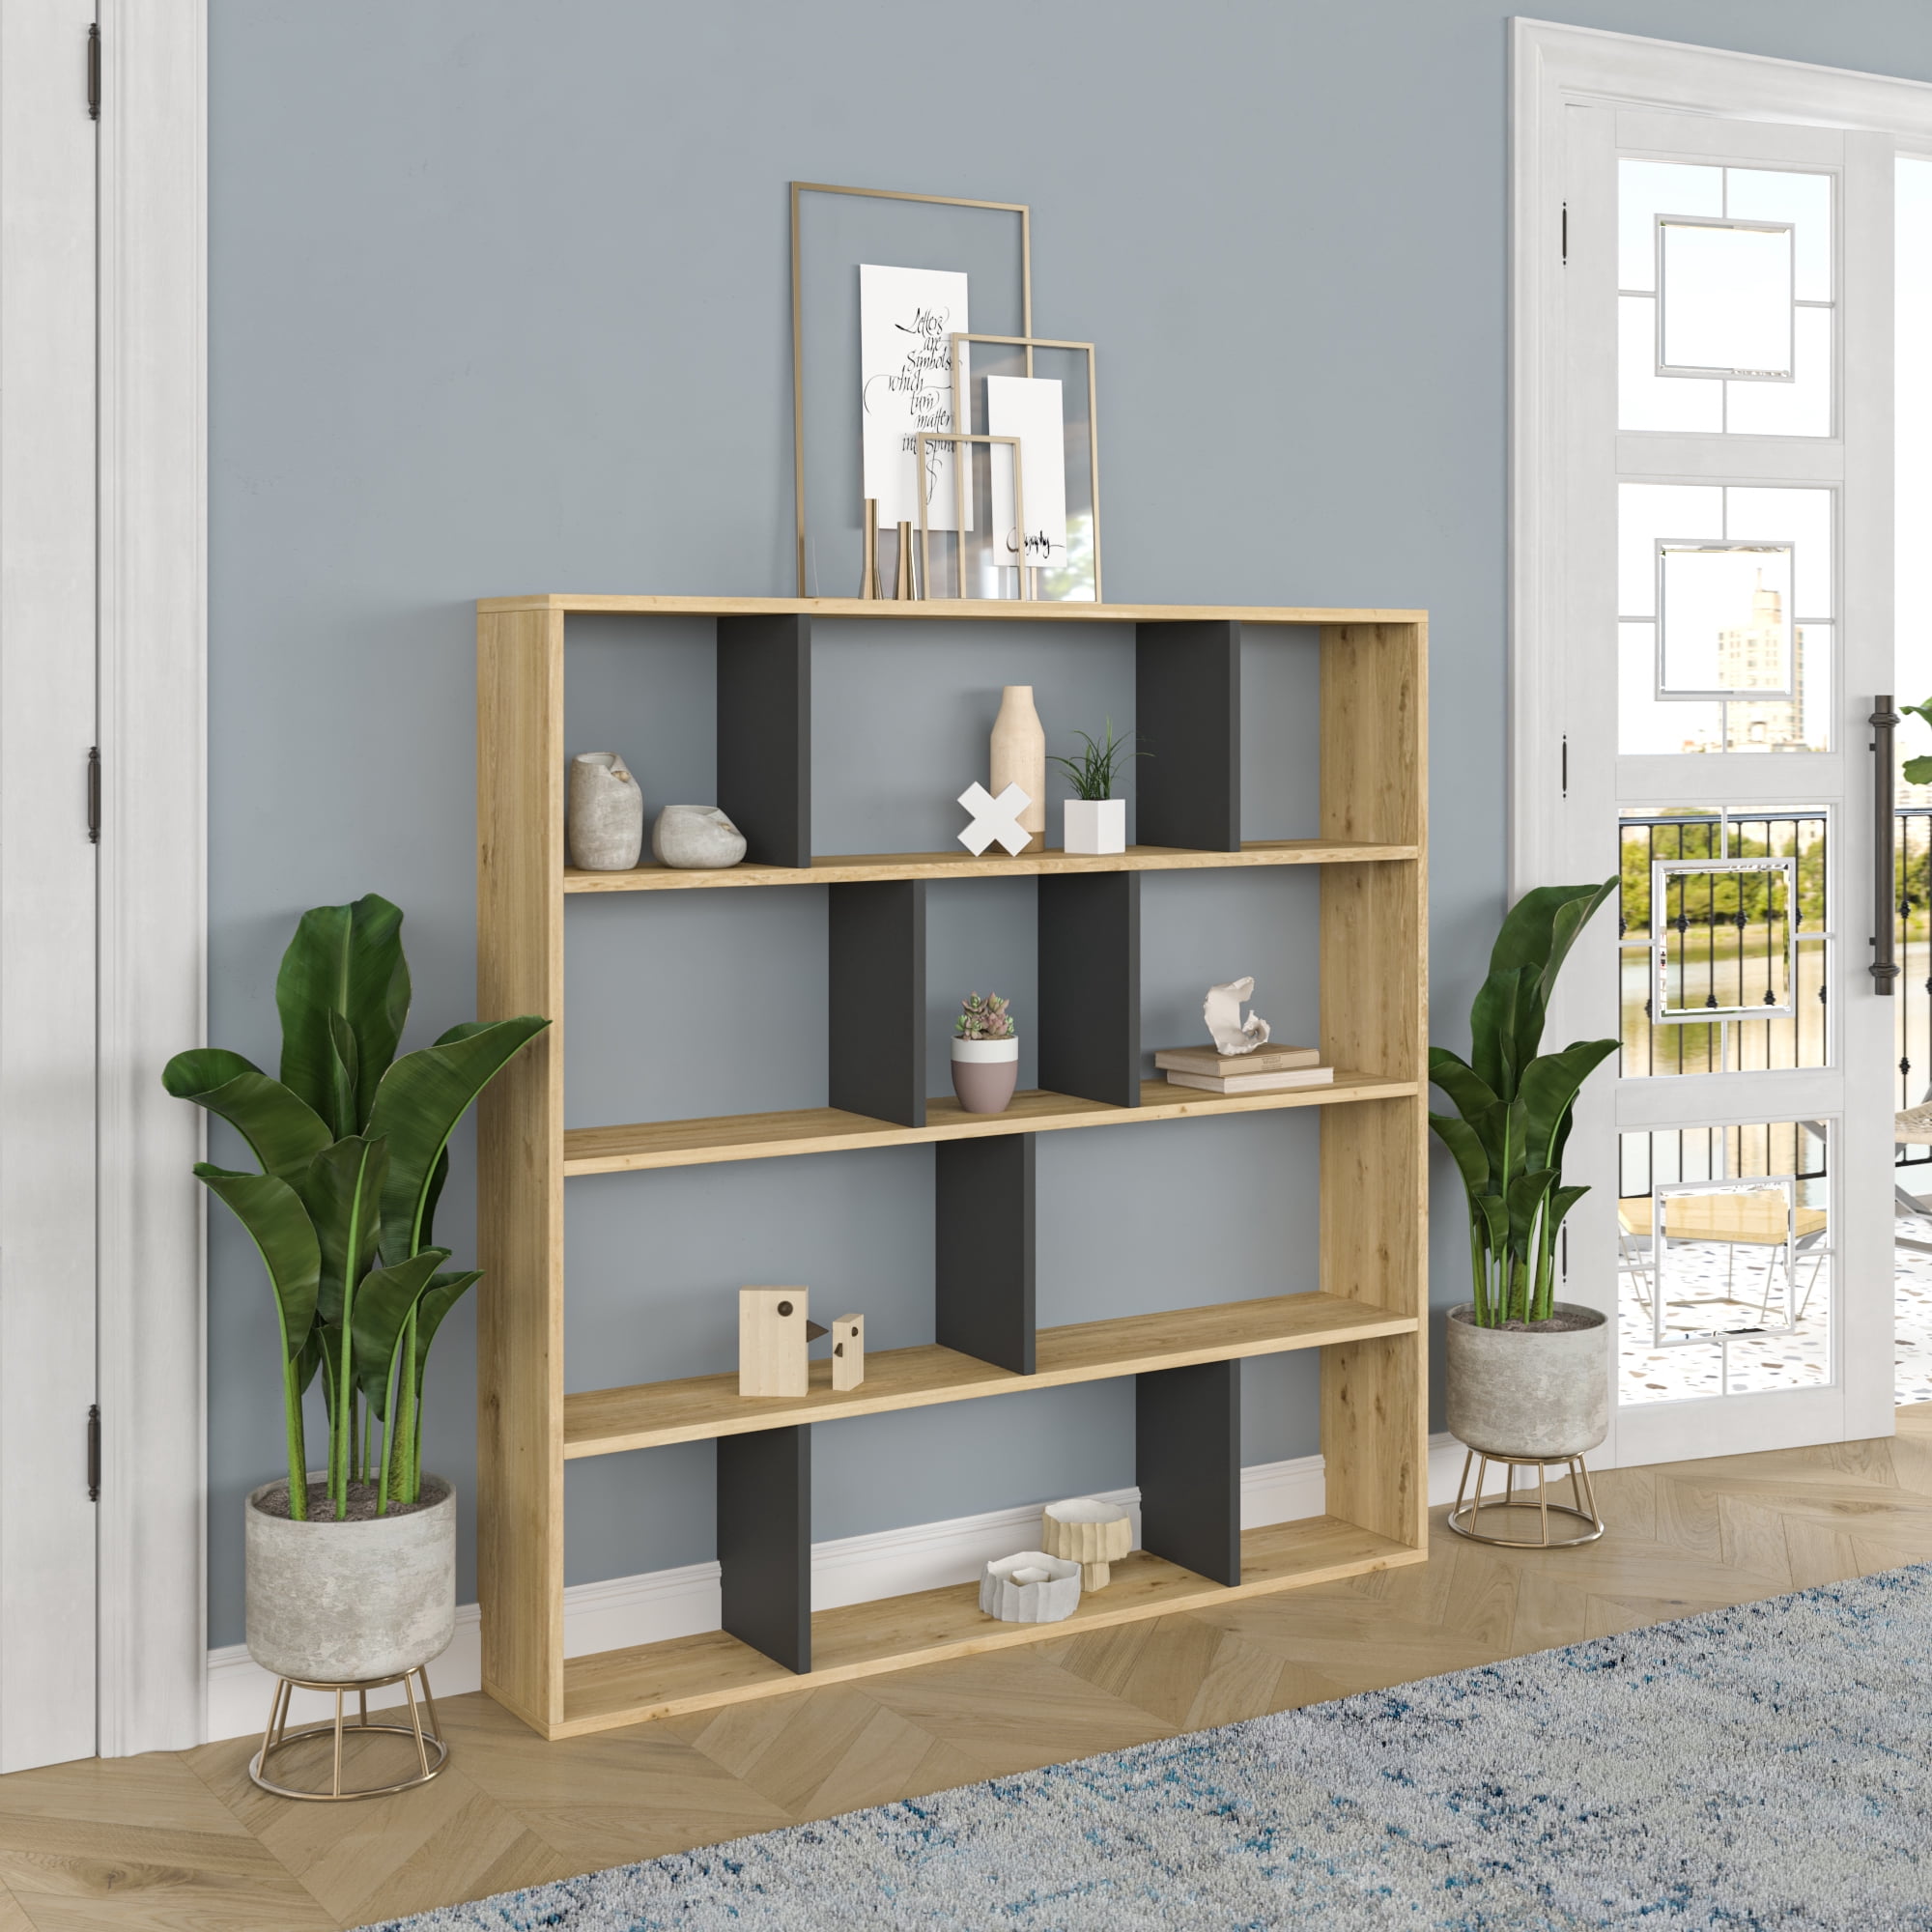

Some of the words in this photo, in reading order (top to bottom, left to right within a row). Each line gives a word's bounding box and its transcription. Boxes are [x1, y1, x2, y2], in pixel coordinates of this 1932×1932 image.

[895, 306, 949, 337] Letters
[923, 336, 946, 352] are
[887, 364, 925, 394] which
[910, 391, 940, 414] turn
[915, 407, 952, 433] matter
[901, 434, 918, 455] int
